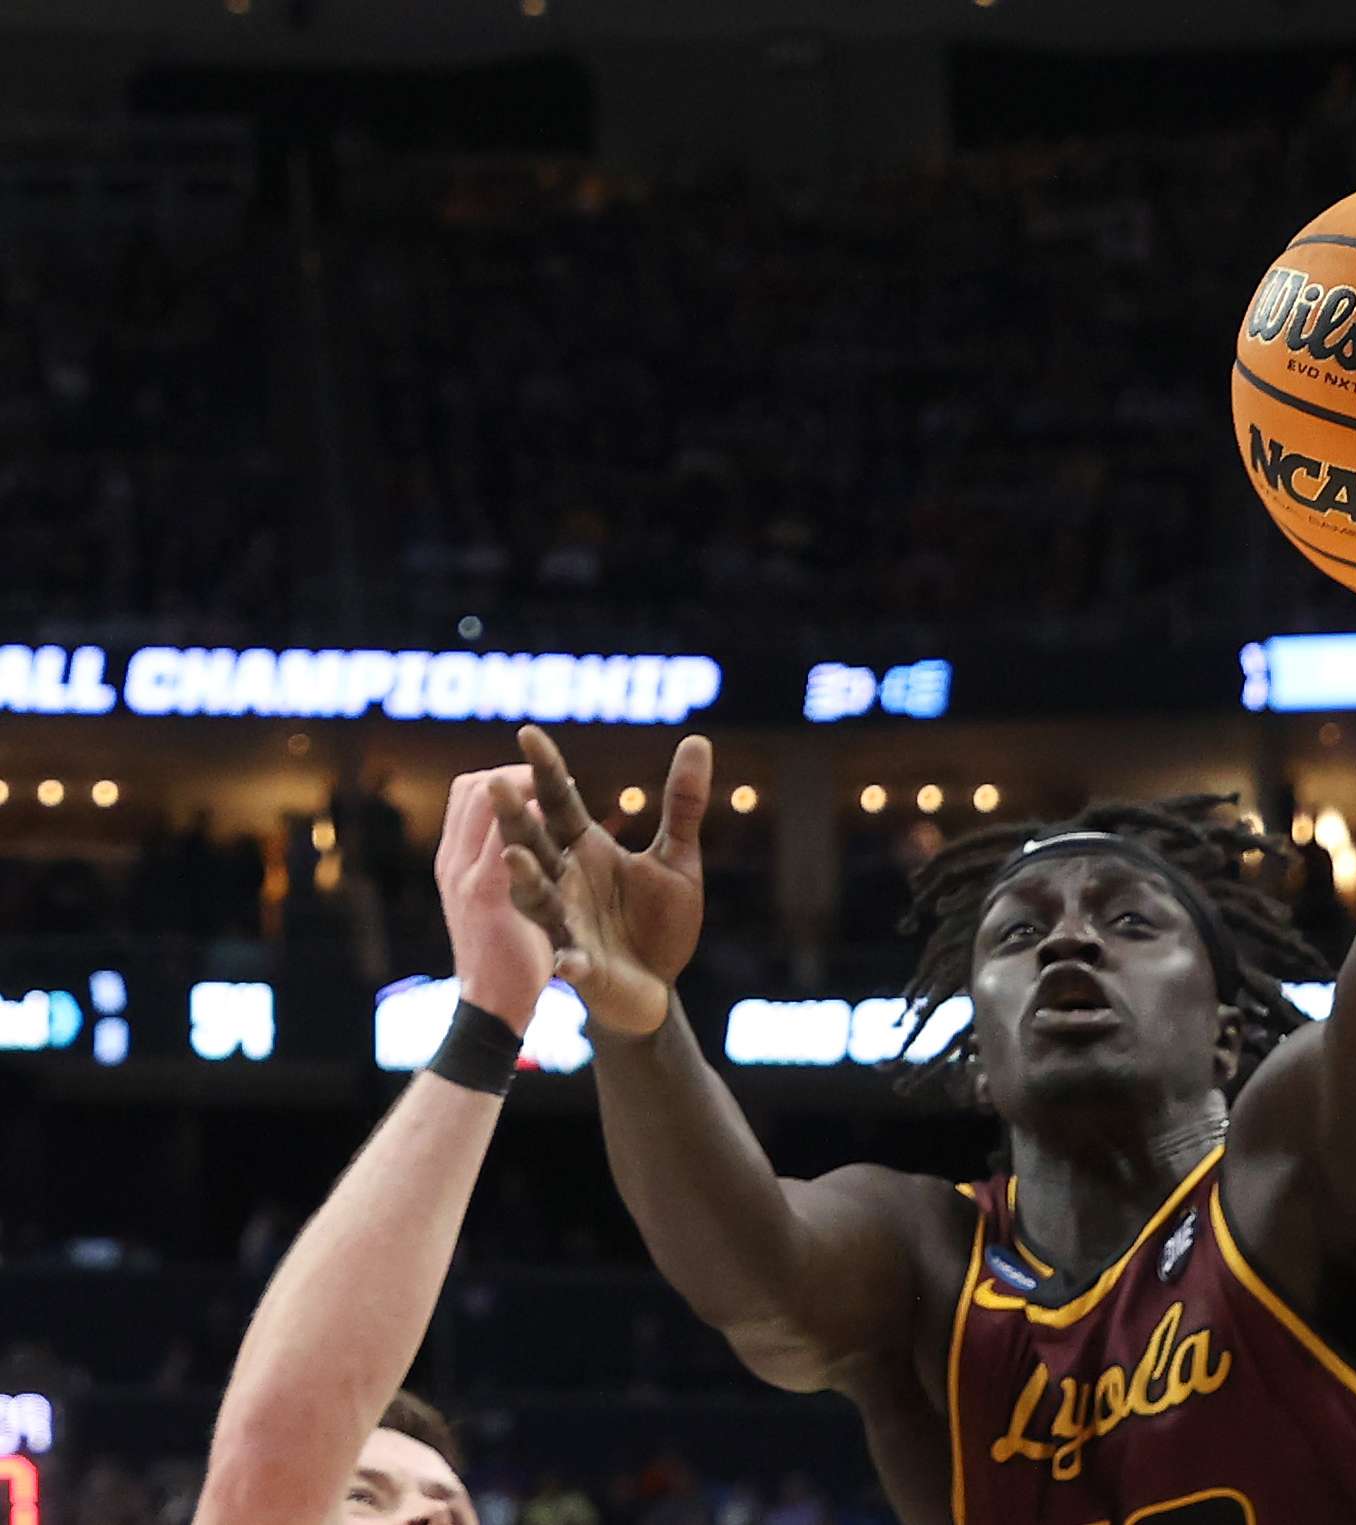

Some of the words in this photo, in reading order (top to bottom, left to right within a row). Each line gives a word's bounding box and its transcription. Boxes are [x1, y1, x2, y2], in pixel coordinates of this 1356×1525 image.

[1286, 358, 1320, 380] EVO
[123, 646, 722, 724] CHAMPIONSHIP
[991, 1302, 1232, 1481] Lyola
